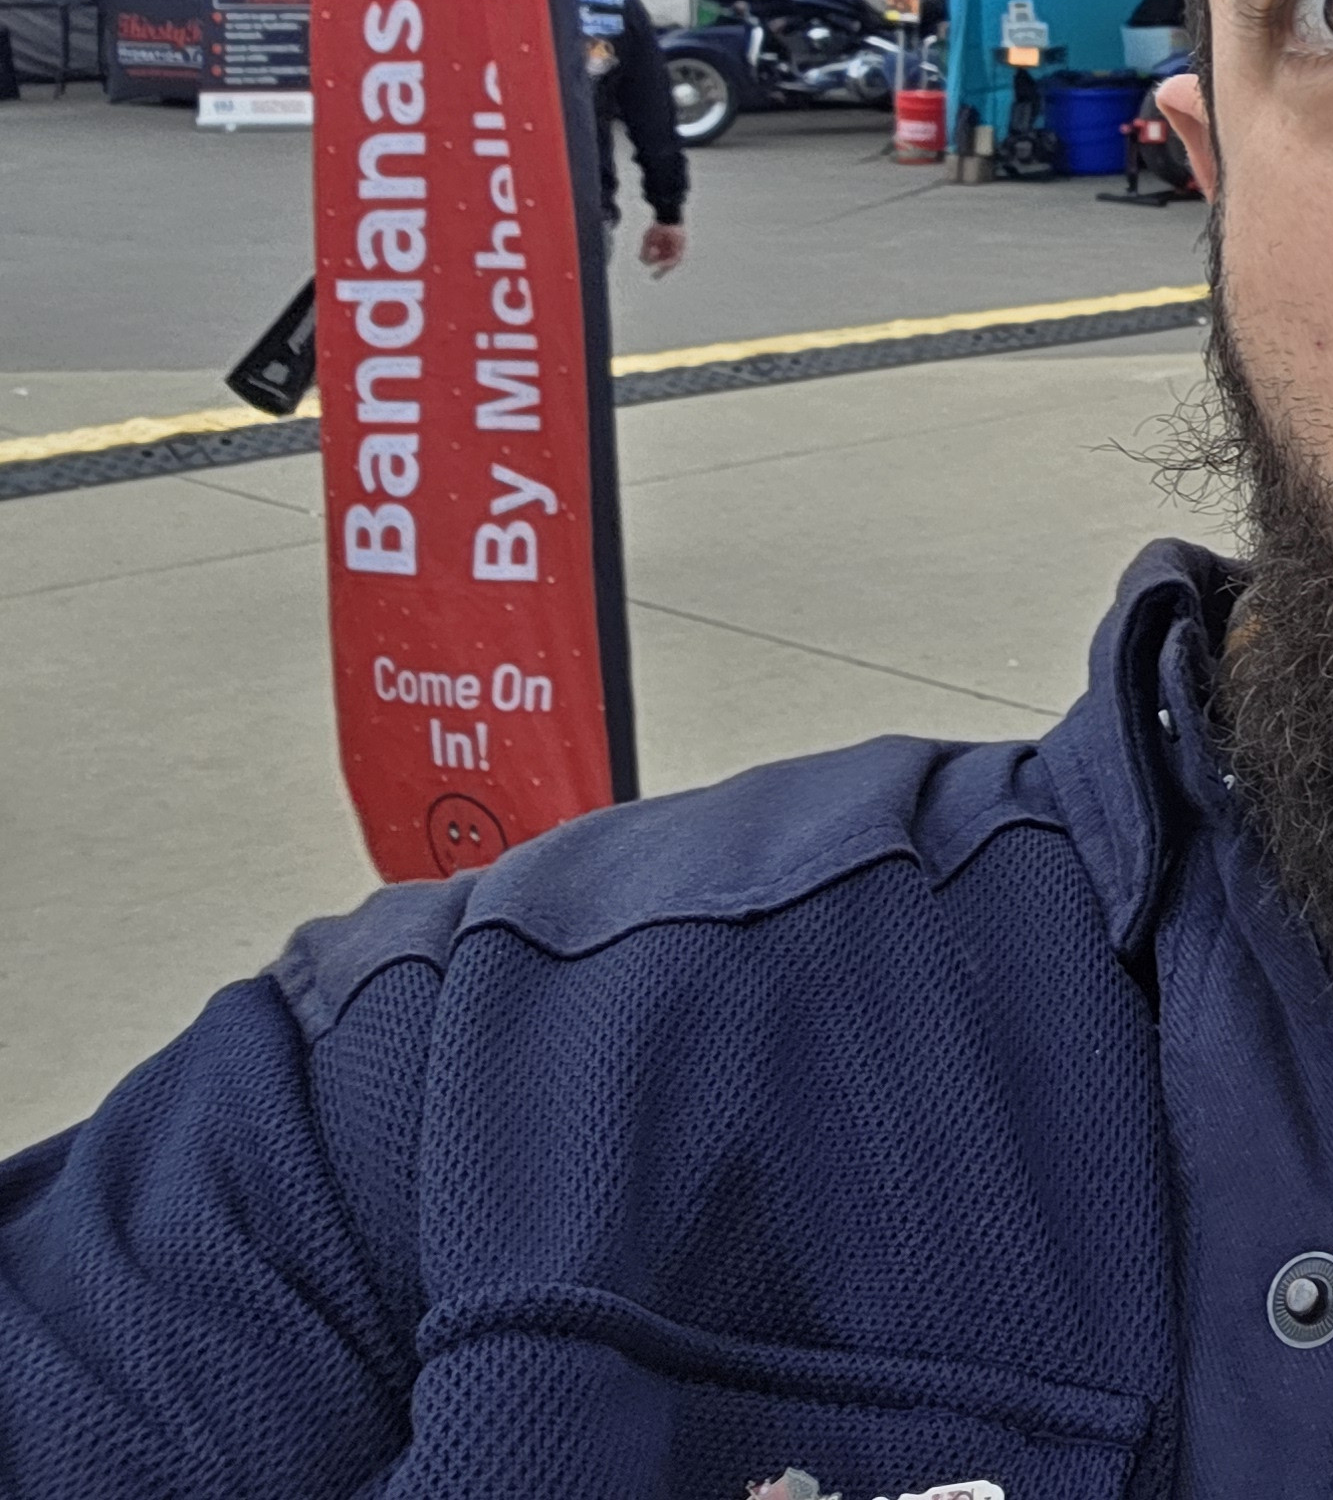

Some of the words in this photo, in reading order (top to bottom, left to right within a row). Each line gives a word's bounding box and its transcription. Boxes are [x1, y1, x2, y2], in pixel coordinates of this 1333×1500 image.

[472, 463, 559, 583] By
[373, 655, 482, 710] Come
[491, 662, 553, 713] On
[430, 718, 490, 772] In!
